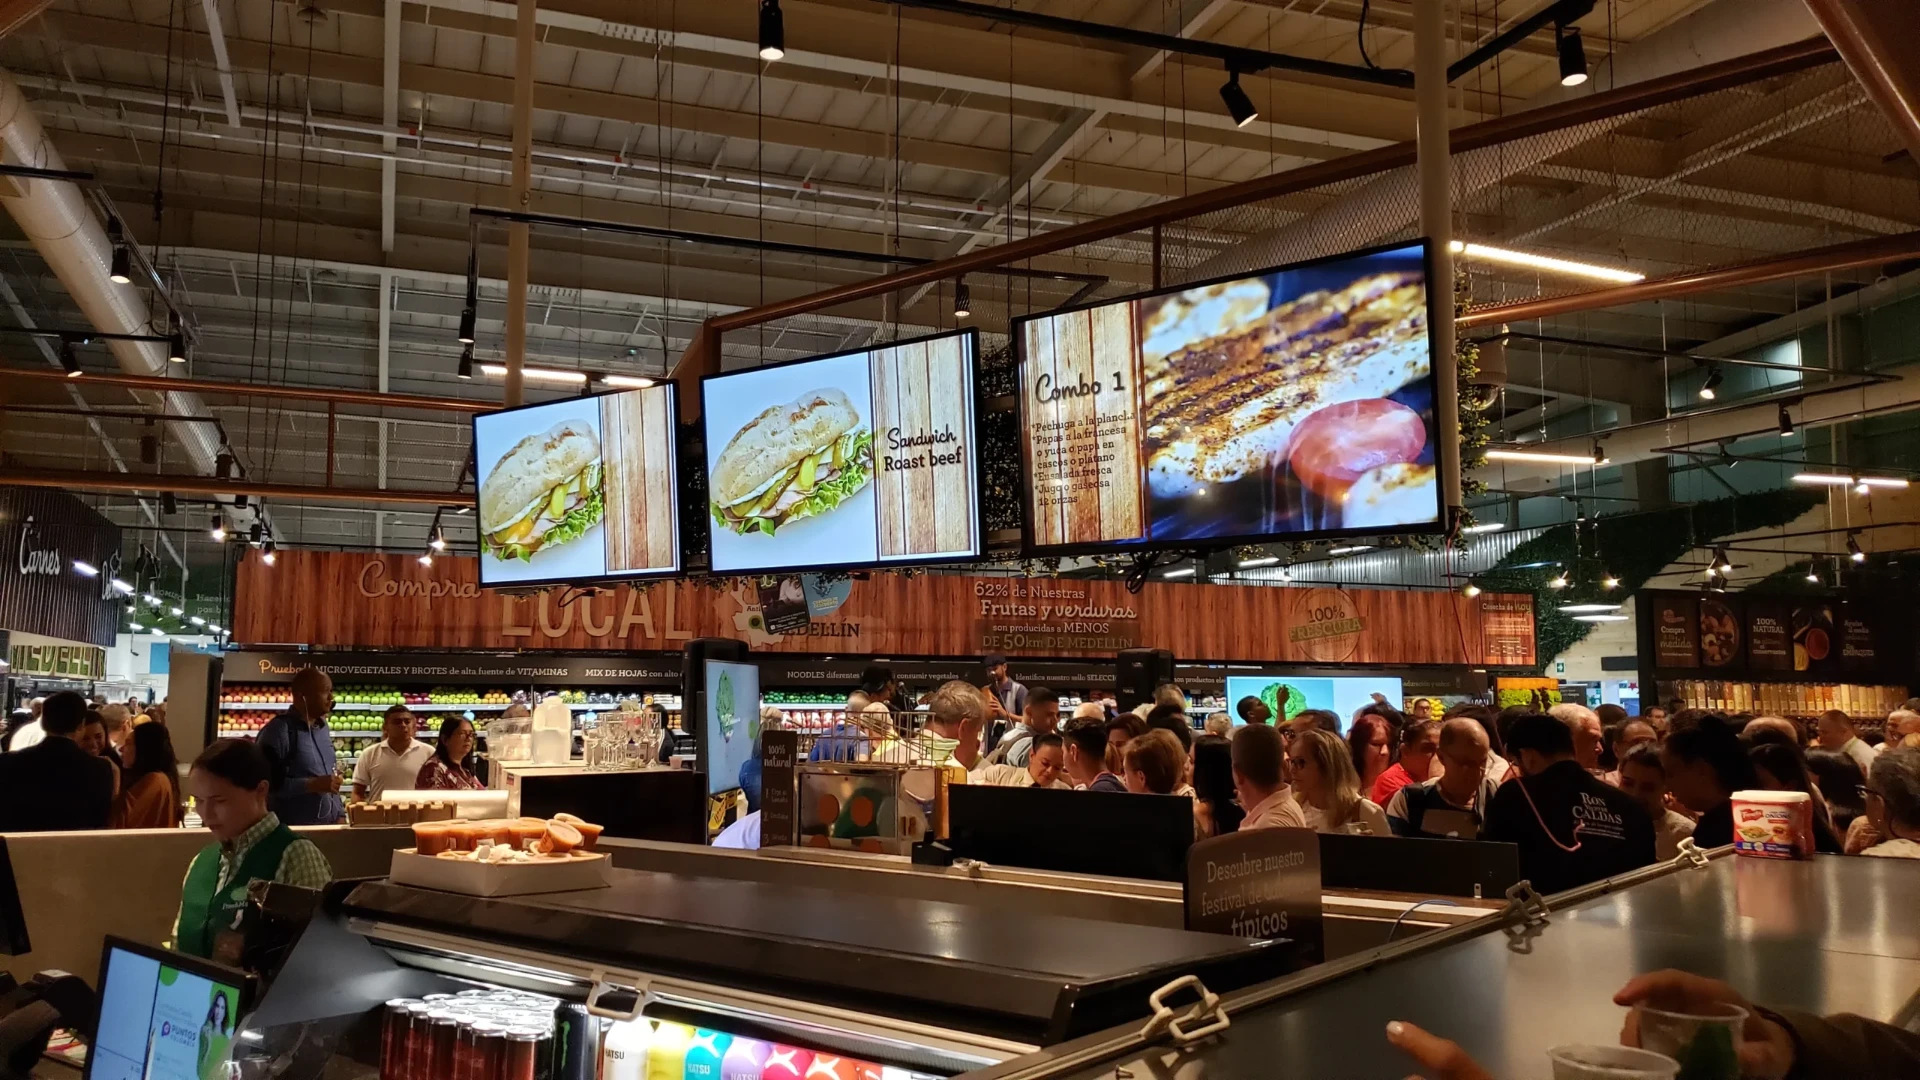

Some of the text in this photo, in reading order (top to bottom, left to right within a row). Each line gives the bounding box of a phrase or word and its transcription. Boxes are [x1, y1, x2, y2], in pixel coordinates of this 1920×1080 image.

[1035, 371, 1125, 404] Combo 1
[1077, 419, 1083, 427] a
[1086, 414, 1094, 426] la
[887, 423, 956, 450] Sandwich
[1066, 432, 1072, 441] a
[1073, 429, 1082, 440] la
[1084, 425, 1127, 440] francesa
[1037, 440, 1115, 457] o yuca o papa en
[884, 445, 962, 472] Roast beef
[1037, 453, 1116, 470] cascos o plátano
[1082, 466, 1112, 479] fresca
[1064, 483, 1070, 492] o
[1072, 480, 1110, 491] gaseosa
[1039, 495, 1078, 506] 12 onzas
[20, 515, 60, 575] Carnes
[974, 581, 1085, 599] 62% de Nuestras
[358, 560, 693, 640] Compra LOCAL
[981, 599, 1137, 620] Frutas y verduras
[1308, 605, 1345, 623] 100%
[992, 624, 1008, 632] son
[1009, 623, 1055, 634] producidas
[1064, 622, 1110, 634] MENOS
[1753, 625, 1785, 634] NATURAL
[1756, 618, 1777, 626] 100%
[983, 634, 1133, 650] DE 50km DE MEDELLÍN
[315, 665, 402, 675] MICROVEGETALES
[403, 666, 411, 675] Y
[411, 666, 448, 675] BROTES
[449, 667, 460, 675] de
[461, 667, 476, 676] alta
[478, 667, 504, 676] fuente
[506, 667, 516, 676] de
[517, 667, 568, 677] VITAMINAS
[585, 669, 679, 678] MIX DE HOJAS con alto
[787, 671, 825, 679] NOODLES
[826, 671, 860, 679] diferentes
[897, 672, 959, 681] consumir vegetales
[1015, 673, 1045, 681] Identifica
[1185, 676, 1215, 684] productos
[768, 744, 786, 755] 100%
[764, 754, 792, 768] natural
[1572, 805, 1623, 825] CALDAS
[1206, 851, 1304, 883] Descubre nuestro
[1202, 883, 1246, 917] festival
[1249, 882, 1262, 905] de
[1231, 908, 1288, 939] típicos
[171, 1024, 197, 1041] PUNTOS
[687, 1063, 711, 1075] HATSU
